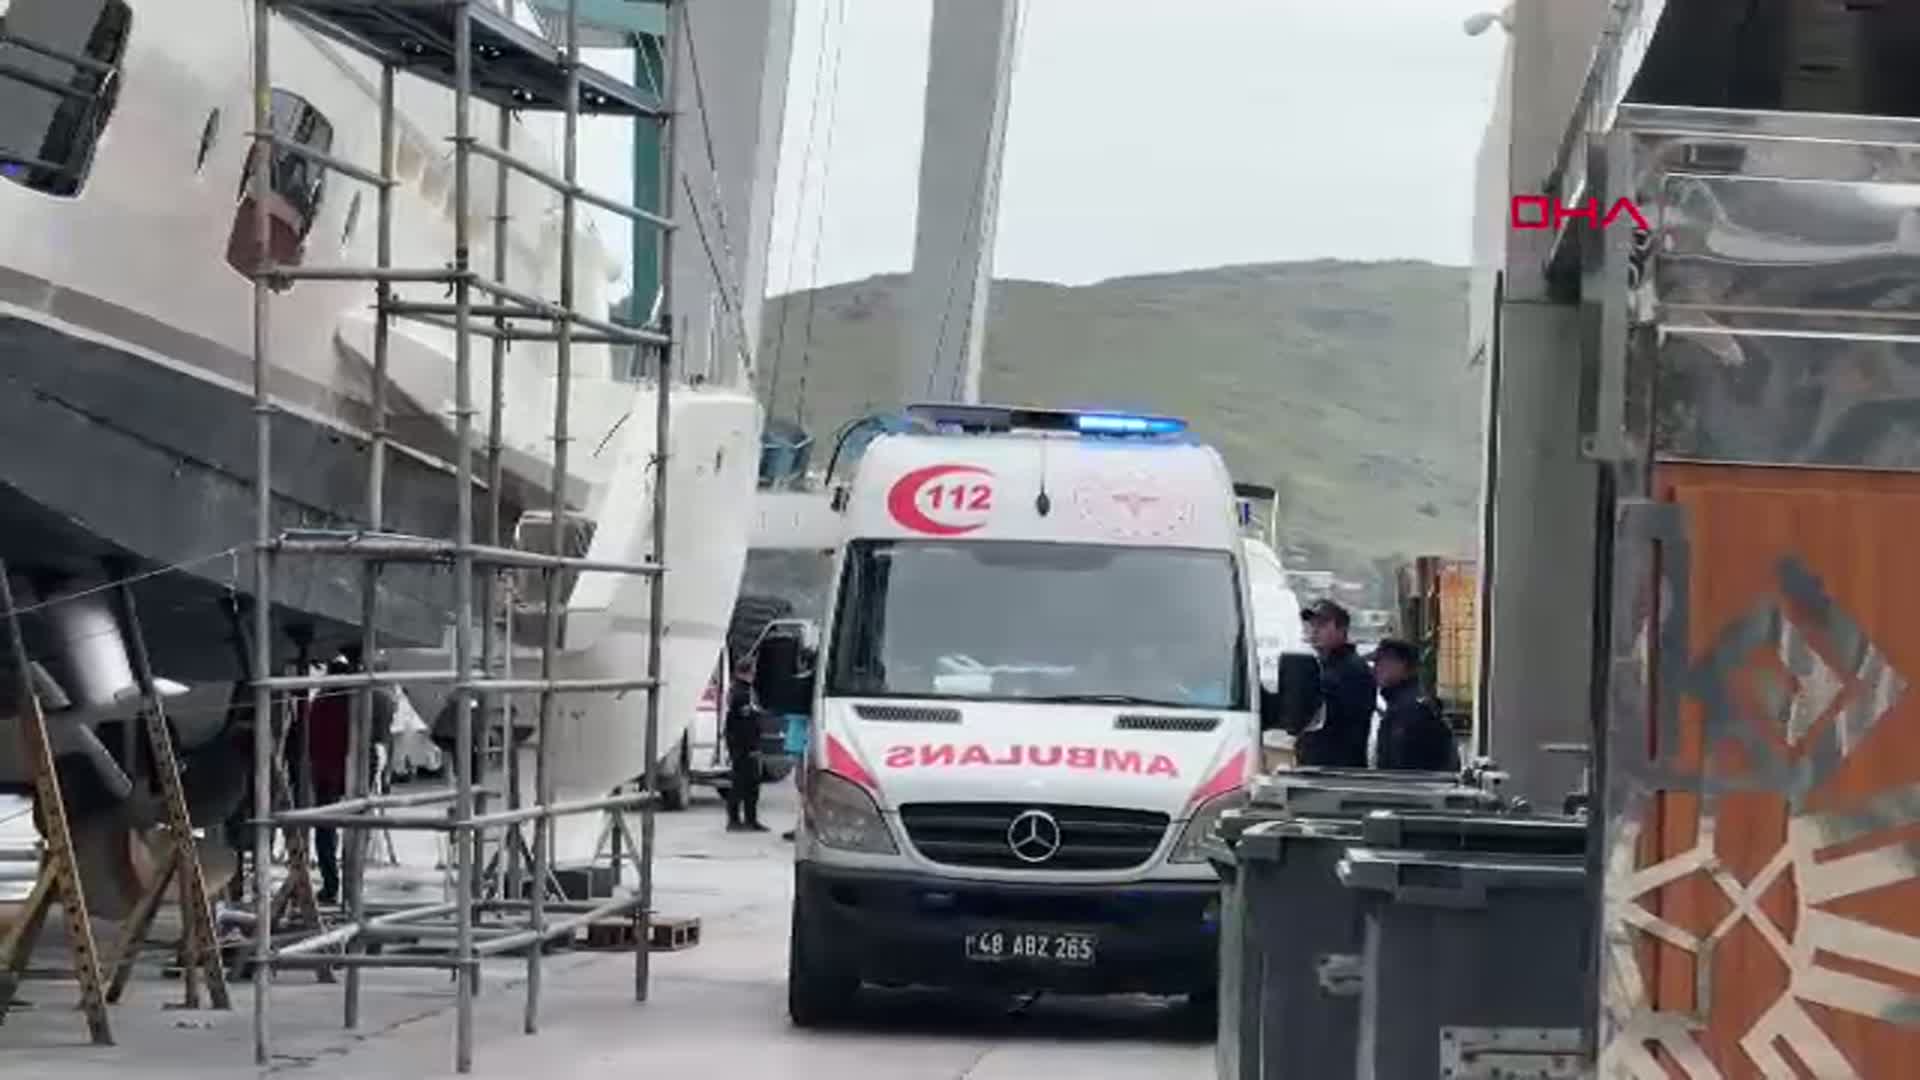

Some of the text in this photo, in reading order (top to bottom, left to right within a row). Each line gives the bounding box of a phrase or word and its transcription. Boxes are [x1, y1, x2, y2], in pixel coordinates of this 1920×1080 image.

[926, 484, 993, 511] 112
[979, 932, 1094, 960] 48 ABZ 265
